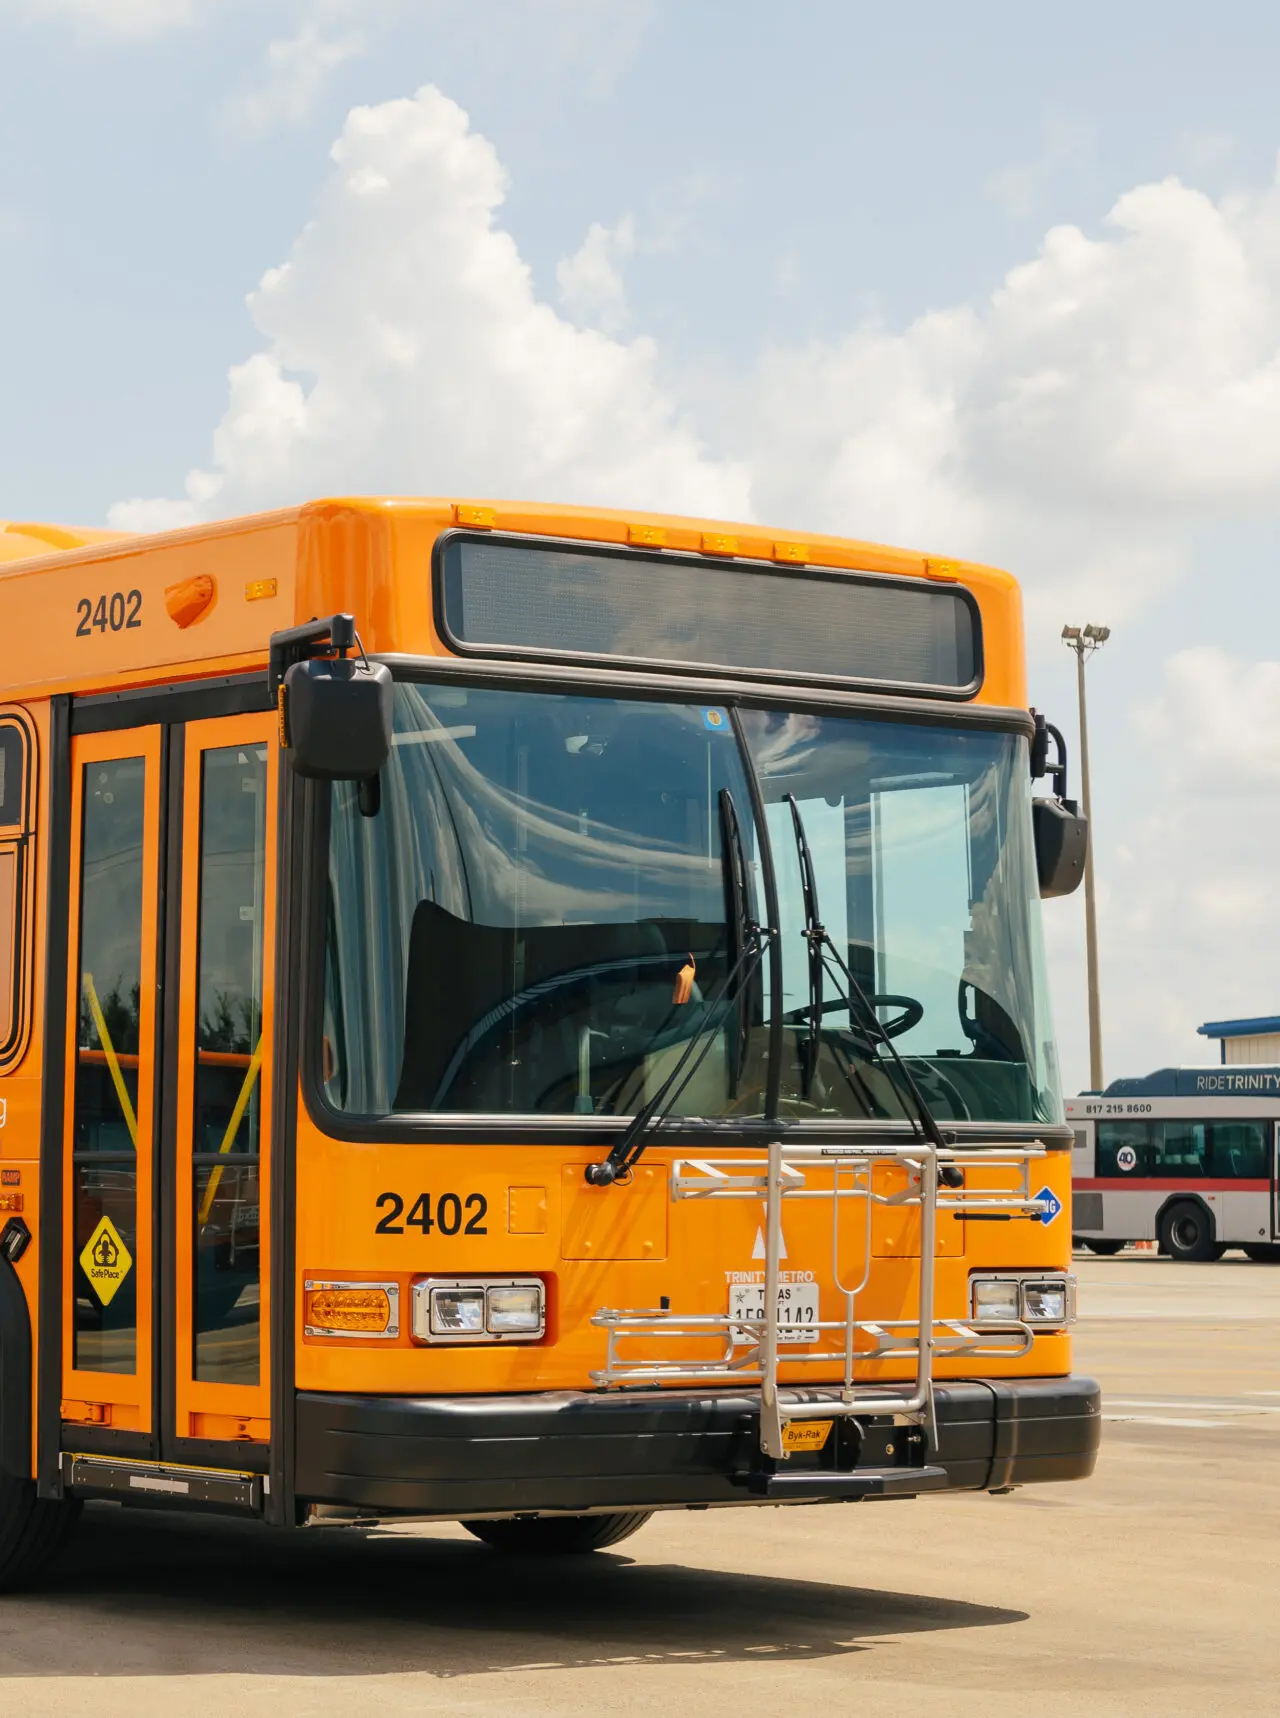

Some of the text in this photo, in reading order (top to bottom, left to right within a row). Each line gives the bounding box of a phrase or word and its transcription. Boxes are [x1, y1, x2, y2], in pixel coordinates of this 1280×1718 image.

[75, 589, 142, 637] 2402
[1086, 1104, 1152, 1114] 817 215 8600
[375, 1192, 488, 1235] 2402
[778, 1271, 814, 1282] ETRO
[758, 1289, 791, 1301] TAS
[788, 1430, 821, 1442] Byk-Rak
